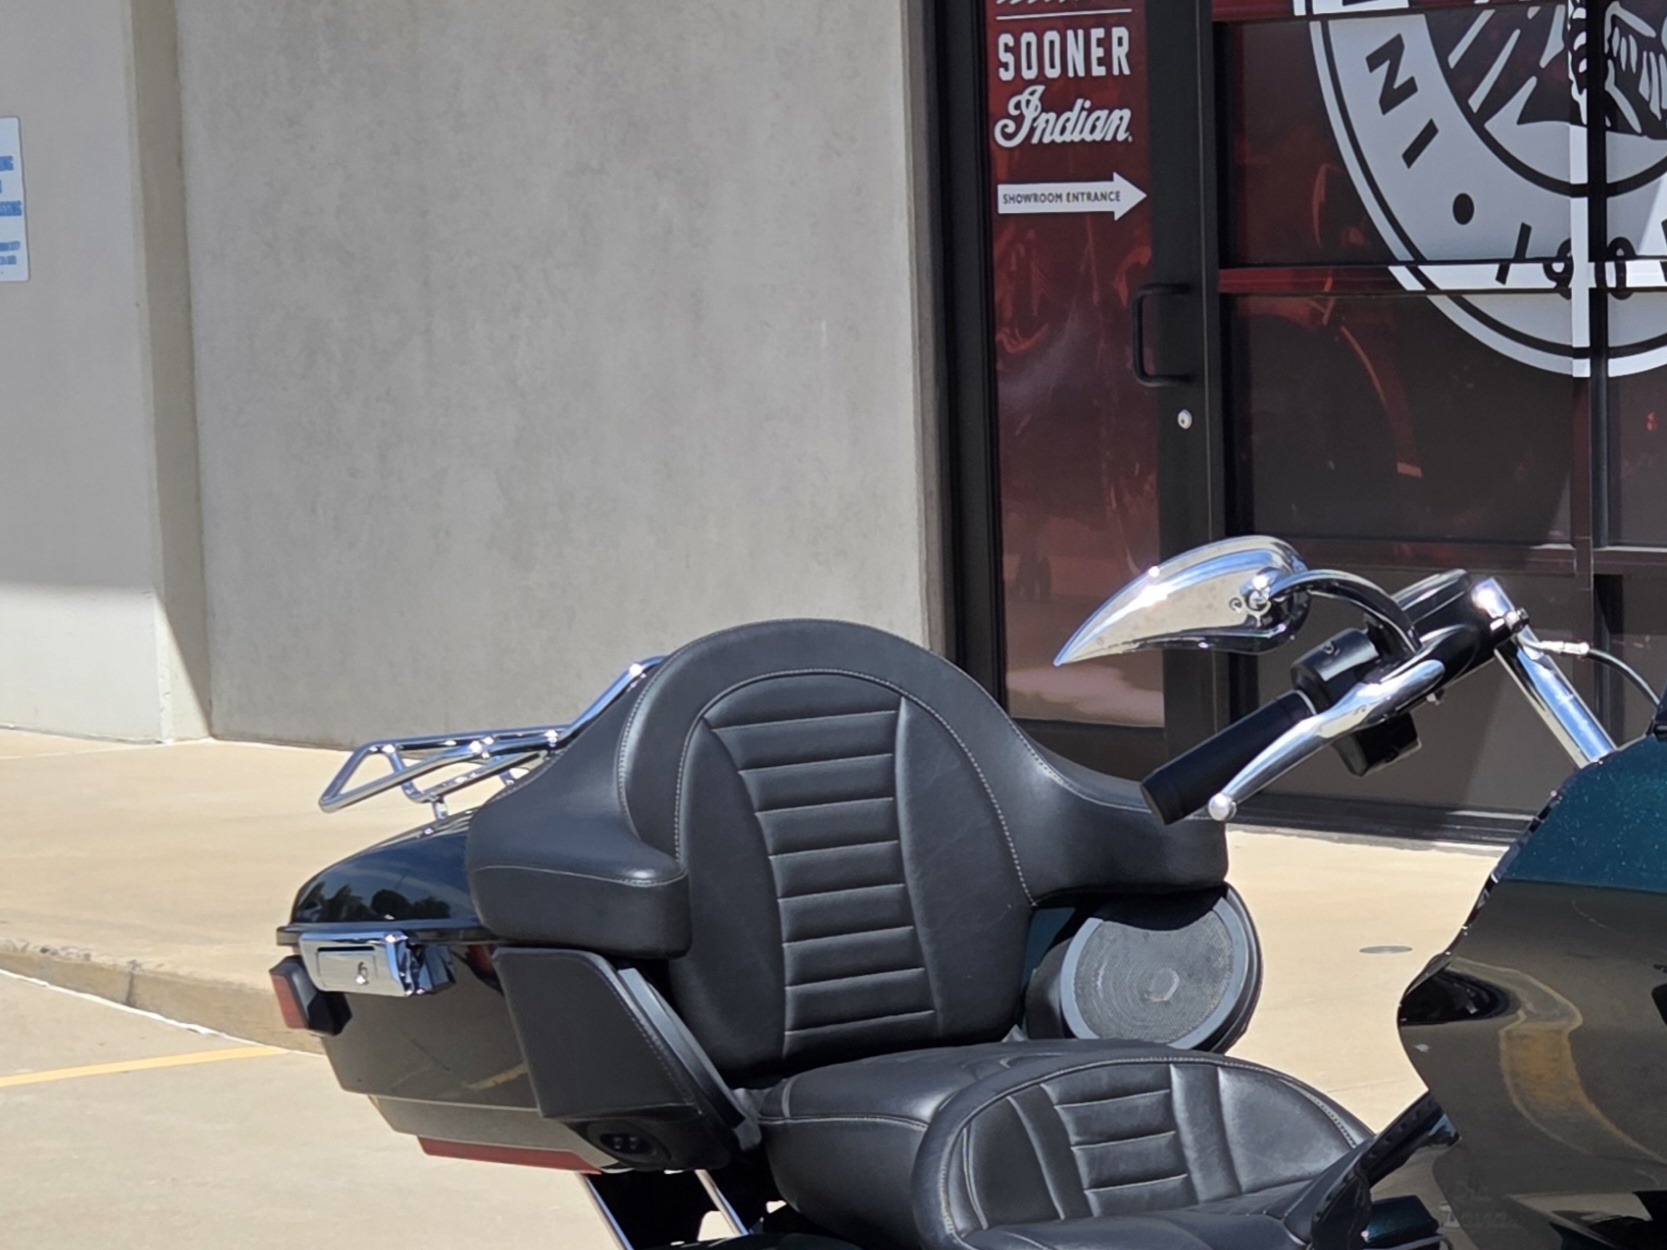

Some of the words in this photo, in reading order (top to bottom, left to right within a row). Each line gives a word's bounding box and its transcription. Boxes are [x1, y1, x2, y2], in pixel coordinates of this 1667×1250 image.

[998, 27, 1131, 81] SOONER
[994, 85, 1133, 148] Indian
[1002, 193, 1063, 204] SHOWROOM
[1065, 190, 1121, 202] ENTRANCE
